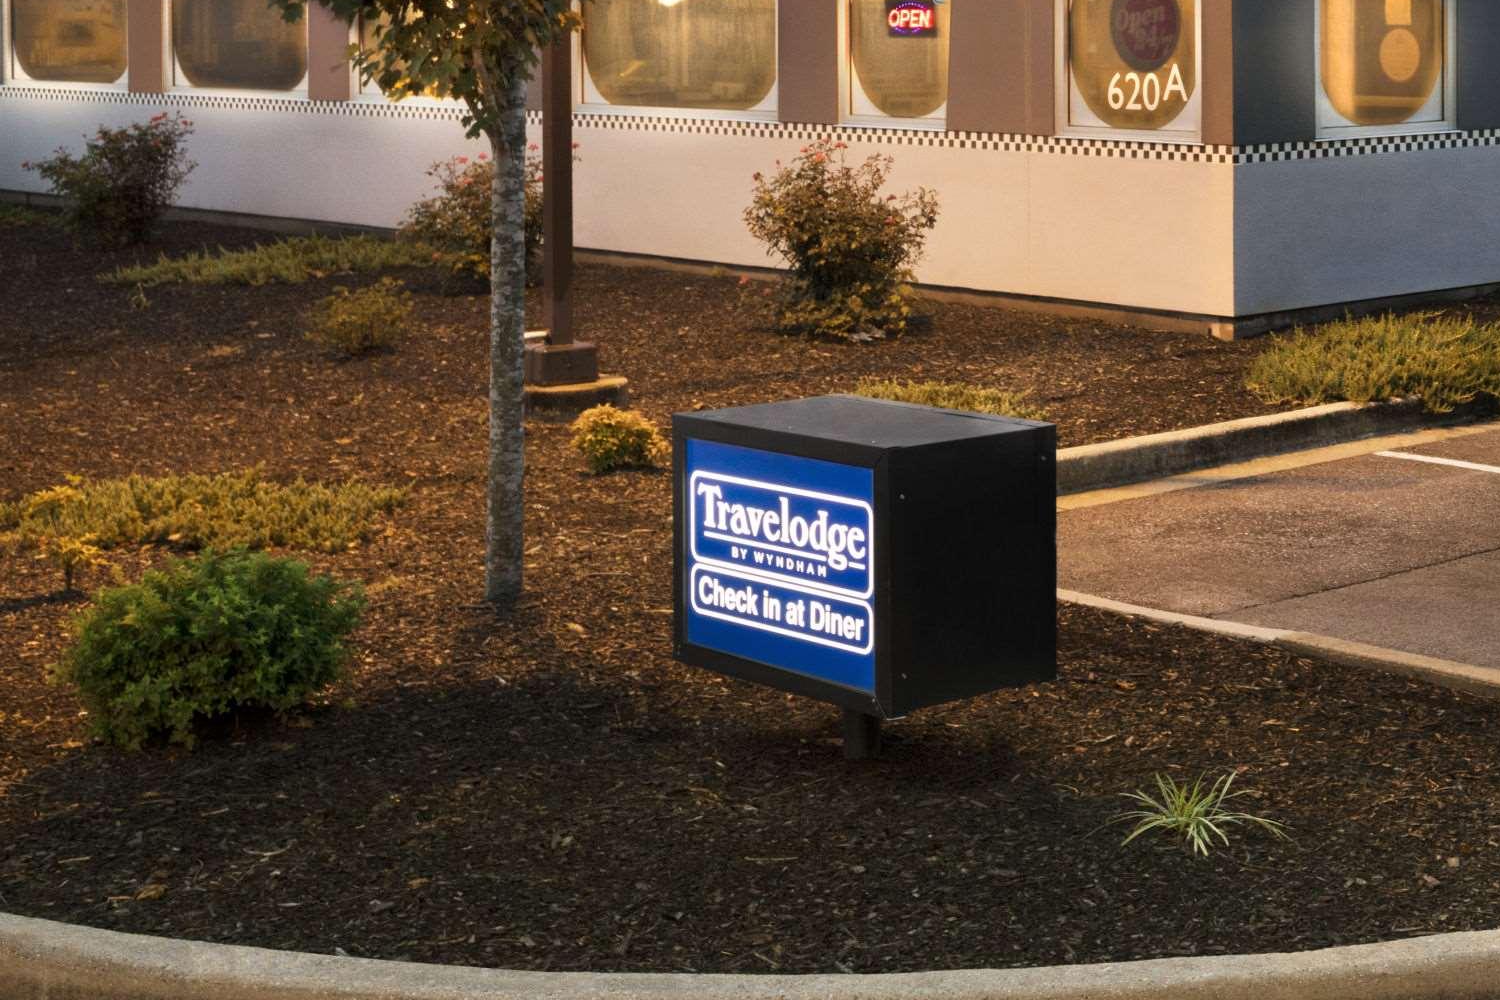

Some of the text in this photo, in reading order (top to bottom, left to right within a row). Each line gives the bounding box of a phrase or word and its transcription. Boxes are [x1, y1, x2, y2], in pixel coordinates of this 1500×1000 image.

[888, 9, 931, 28] OPEN
[697, 481, 866, 572] Travelodge
[731, 546, 827, 578] BY WYNDHAM
[699, 575, 864, 641] Check in at Diner
